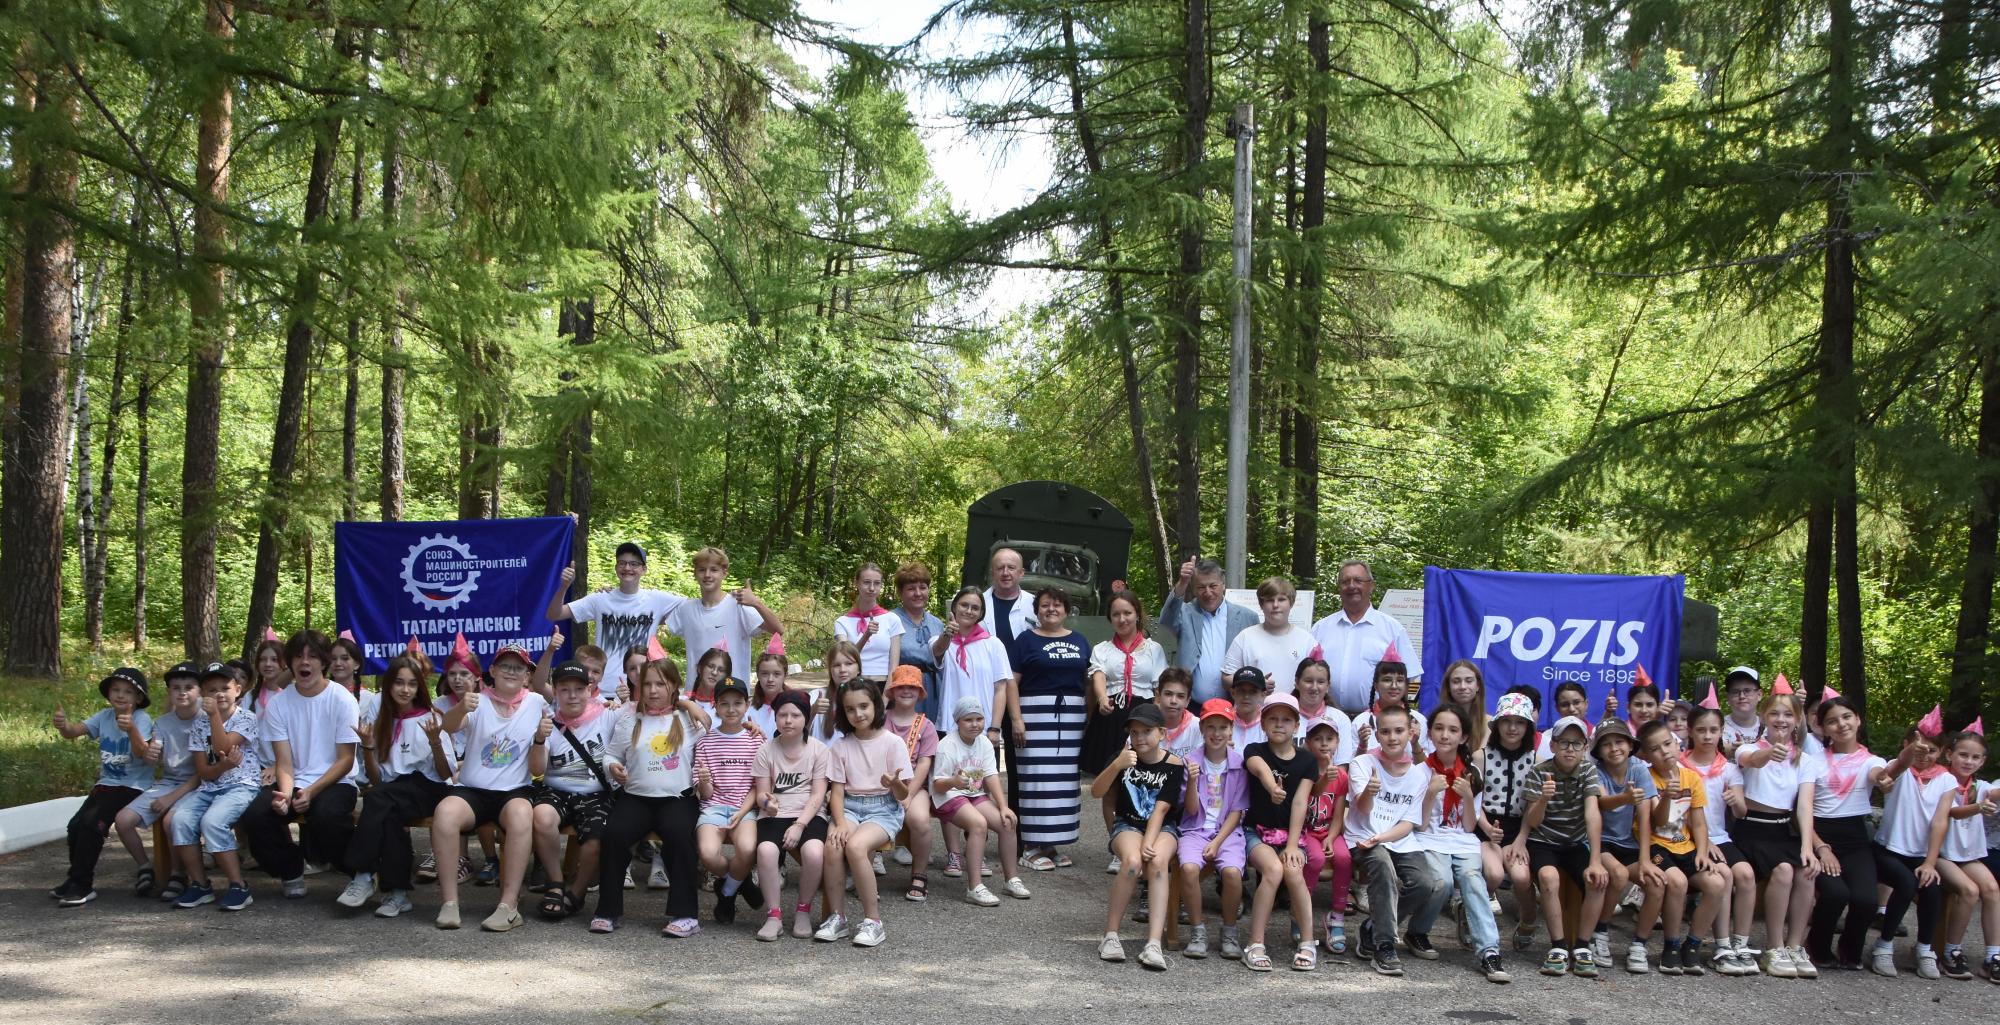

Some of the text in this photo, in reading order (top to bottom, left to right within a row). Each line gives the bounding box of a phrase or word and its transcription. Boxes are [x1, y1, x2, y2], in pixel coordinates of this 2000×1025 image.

[425, 550, 453, 560] СОЮЗ
[425, 556, 527, 571] МАШИНОСТРОИТЕЛЕЙ
[426, 571, 463, 582] РОССИИ
[402, 616, 521, 635] ТАТАРСТАНСКОЕ
[1472, 615, 1646, 666] POZIS
[364, 640, 475, 658] РЕГИОАЛЬНЕ
[1542, 666, 1637, 684] Since 1898
[776, 772, 802, 786] NIKE
[1376, 789, 1413, 805] LANTA
